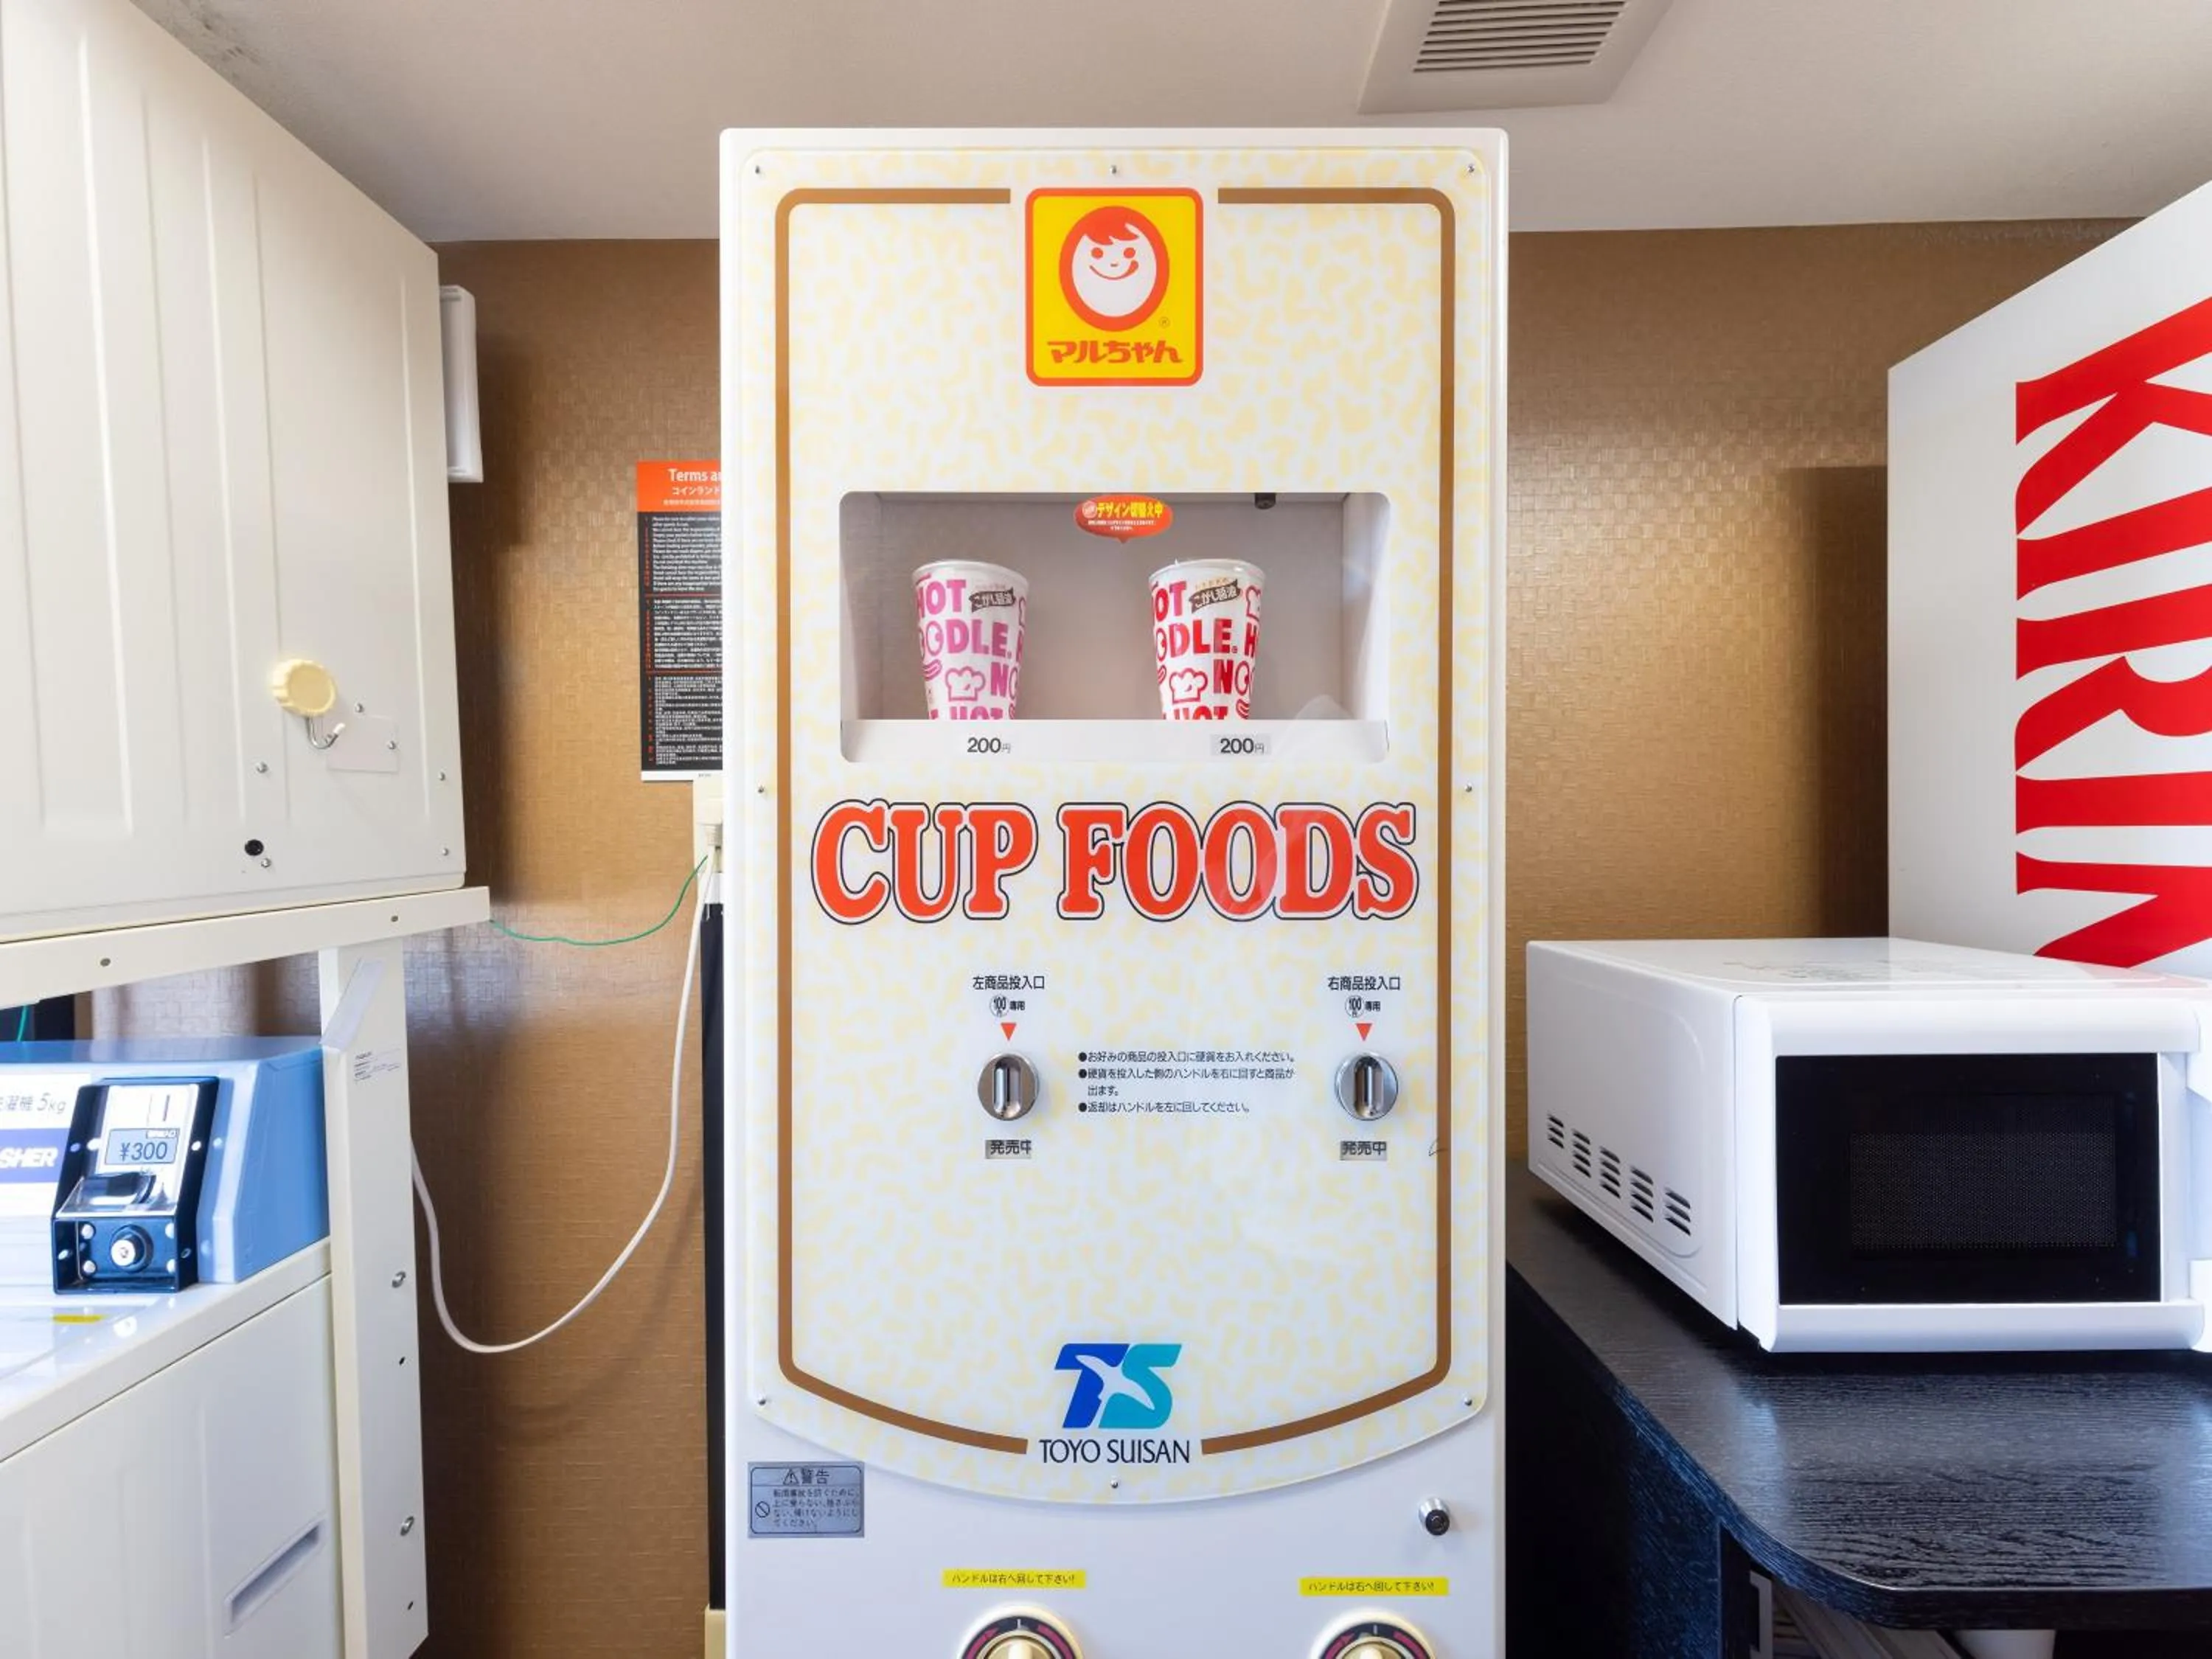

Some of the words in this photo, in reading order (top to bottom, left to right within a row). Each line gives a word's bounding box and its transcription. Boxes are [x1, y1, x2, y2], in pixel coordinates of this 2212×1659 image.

[1047, 340, 1183, 364] マルちゃん
[667, 467, 709, 481] Terms
[811, 799, 1039, 925] CUP
[1057, 800, 1420, 923] FOODS
[972, 975, 1046, 991] 左商品投入口
[1327, 975, 1401, 991] 右商品投入口
[1088, 1085, 1119, 1096] 出ます。
[119, 1141, 168, 1162] ¥300
[990, 1139, 1032, 1155] 発売中
[1341, 1141, 1387, 1156] 発売中
[1040, 1439, 1101, 1464] TOYO
[1107, 1439, 1190, 1464] SUISAN
